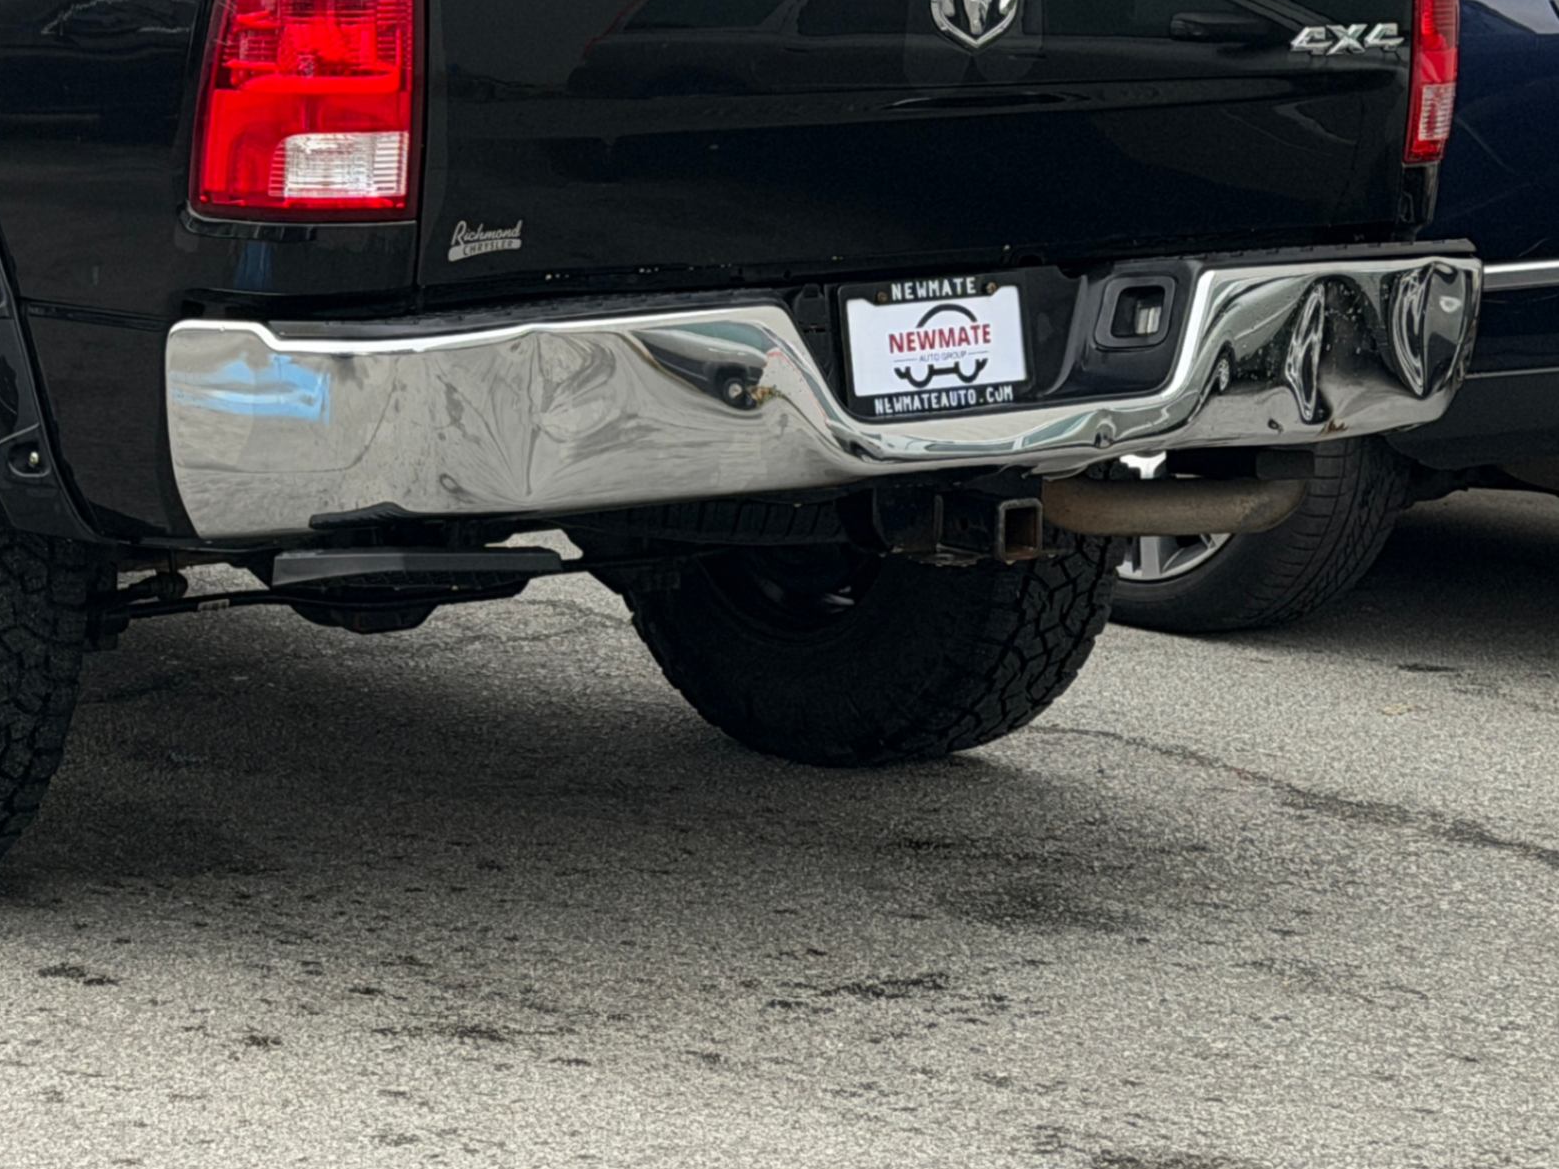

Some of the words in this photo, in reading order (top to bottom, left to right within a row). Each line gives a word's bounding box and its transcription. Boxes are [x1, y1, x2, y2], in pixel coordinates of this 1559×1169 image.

[1290, 22, 1404, 56] 4X4
[451, 219, 523, 246] Richmond
[462, 239, 514, 256] CHRYSLER
[891, 276, 976, 301] NEWMATE
[888, 323, 991, 354] NEWMATE
[919, 353, 940, 363] AUTO
[942, 350, 967, 362] GROUP
